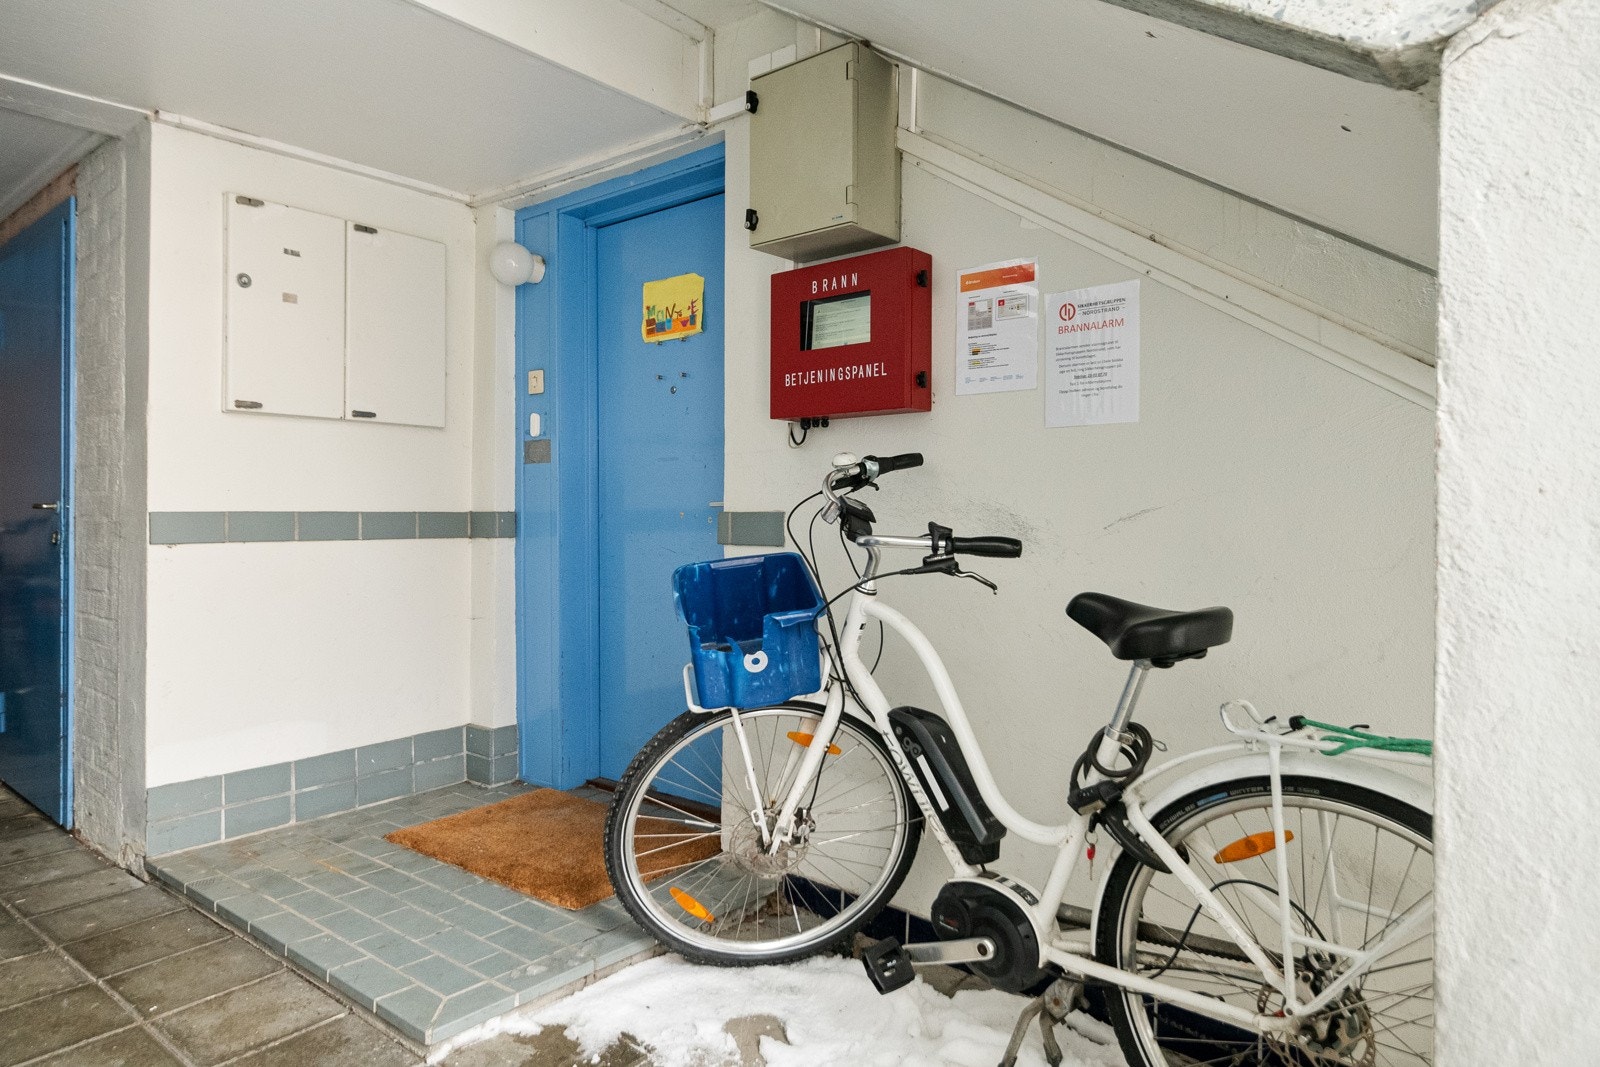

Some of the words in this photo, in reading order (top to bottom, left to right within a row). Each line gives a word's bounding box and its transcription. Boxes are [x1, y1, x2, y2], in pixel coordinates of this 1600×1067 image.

[812, 273, 859, 294] BRANN
[1081, 306, 1120, 316] NORDSTRAND
[1057, 318, 1125, 335] BRANNALARM
[785, 362, 888, 387] BETJENINGSPANEL
[1266, 785, 1294, 793] PUS
